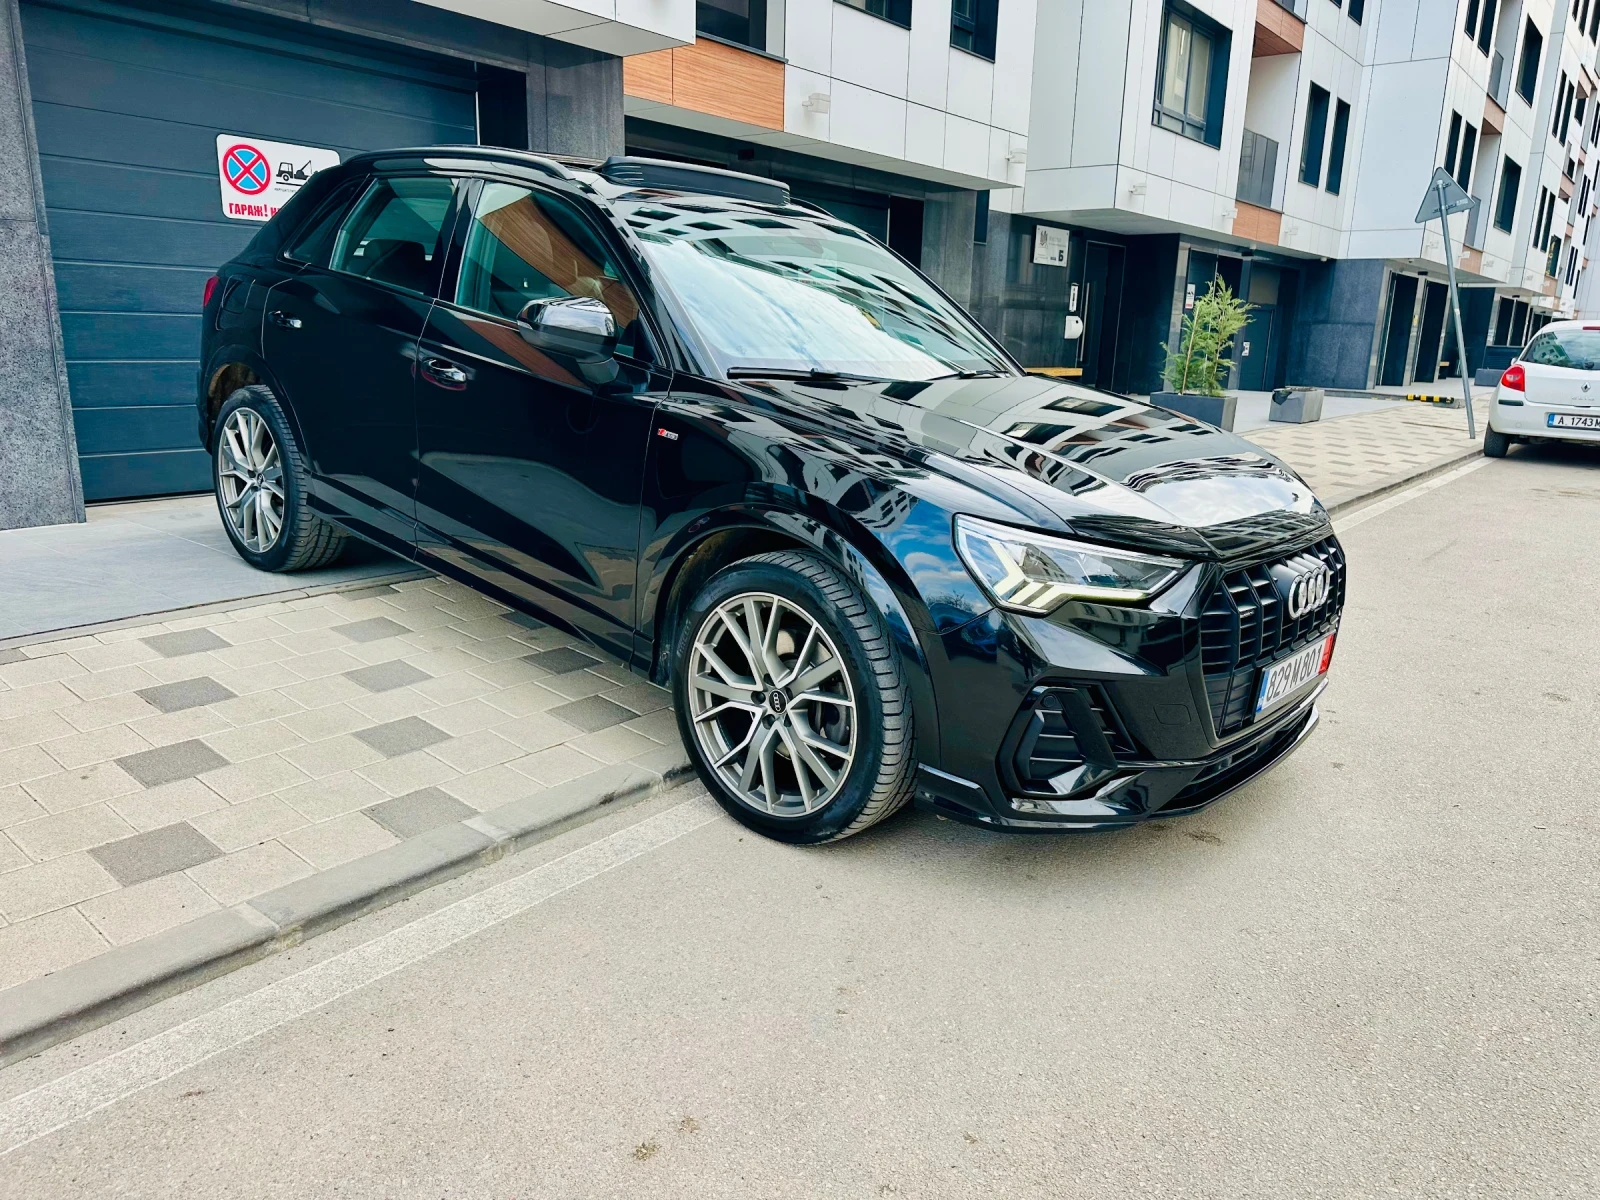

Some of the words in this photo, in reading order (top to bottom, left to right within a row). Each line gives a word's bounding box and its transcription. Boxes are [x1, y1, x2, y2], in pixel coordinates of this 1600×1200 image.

[229, 203, 268, 217] ГАРАЖ!
[1558, 416, 1564, 425] A
[1571, 417, 1594, 427] 1743
